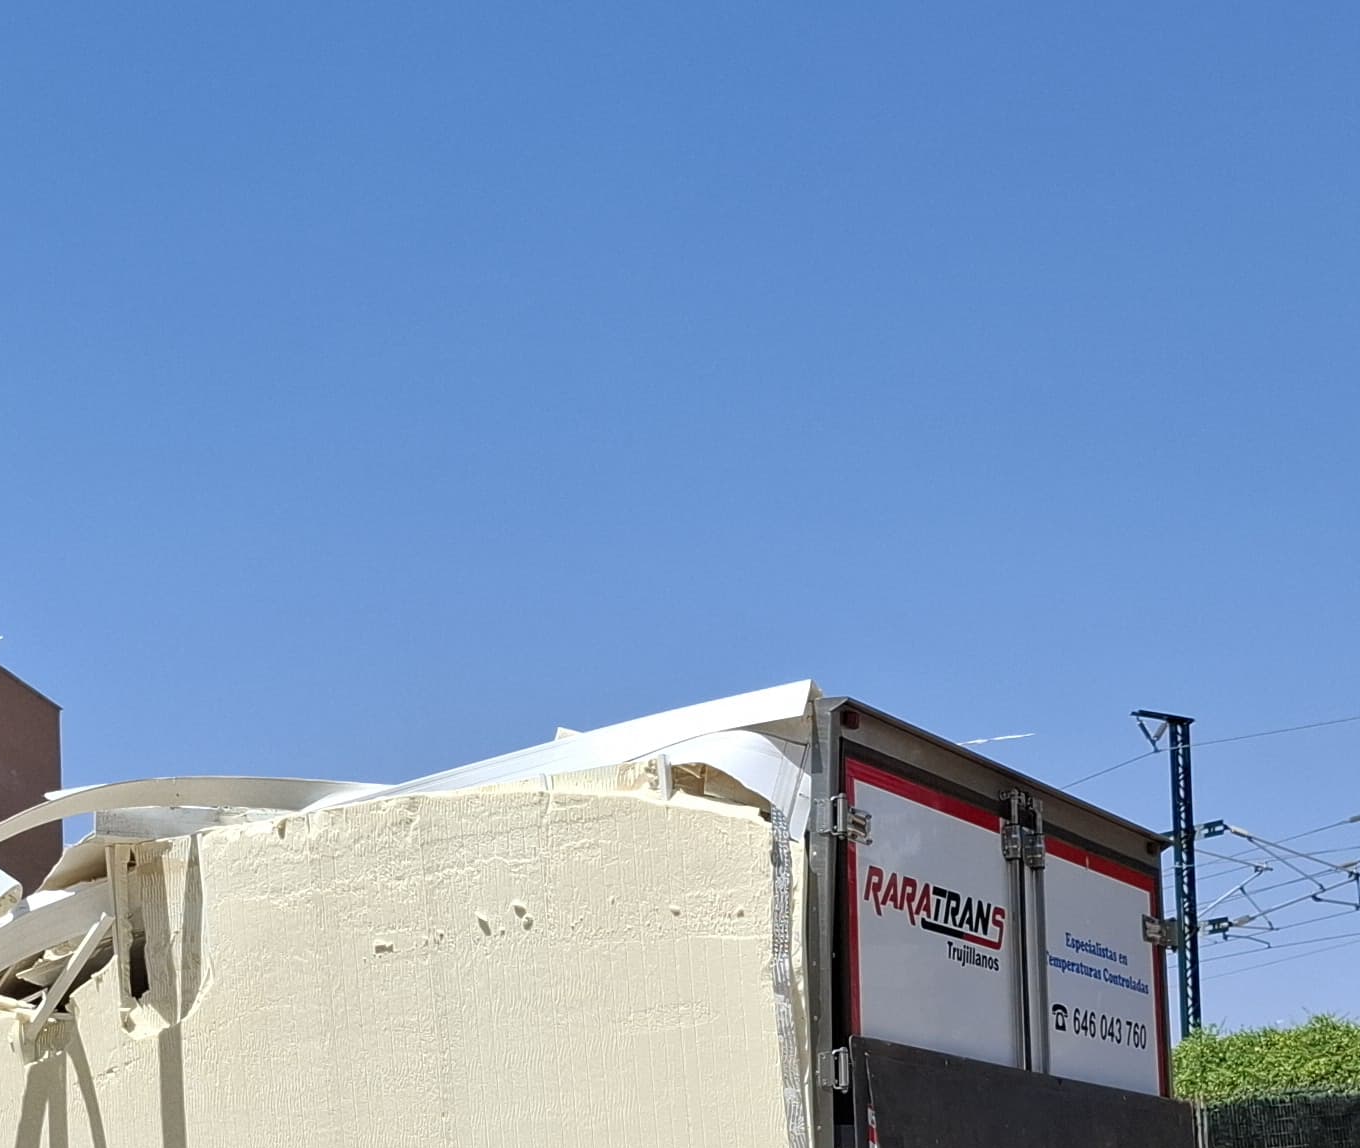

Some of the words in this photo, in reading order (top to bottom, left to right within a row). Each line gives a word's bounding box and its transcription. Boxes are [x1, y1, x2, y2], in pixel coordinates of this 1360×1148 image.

[864, 865, 1006, 950] RARATRANS
[947, 941, 1000, 971] Trujillanos
[1065, 932, 1117, 962] Especialistas
[1118, 953, 1128, 966] en
[1046, 950, 1101, 980] emperaturas
[1102, 967, 1149, 994] Controladas
[1073, 1007, 1097, 1038] 646
[1100, 1014, 1122, 1044] 043
[1126, 1020, 1147, 1050] 760
